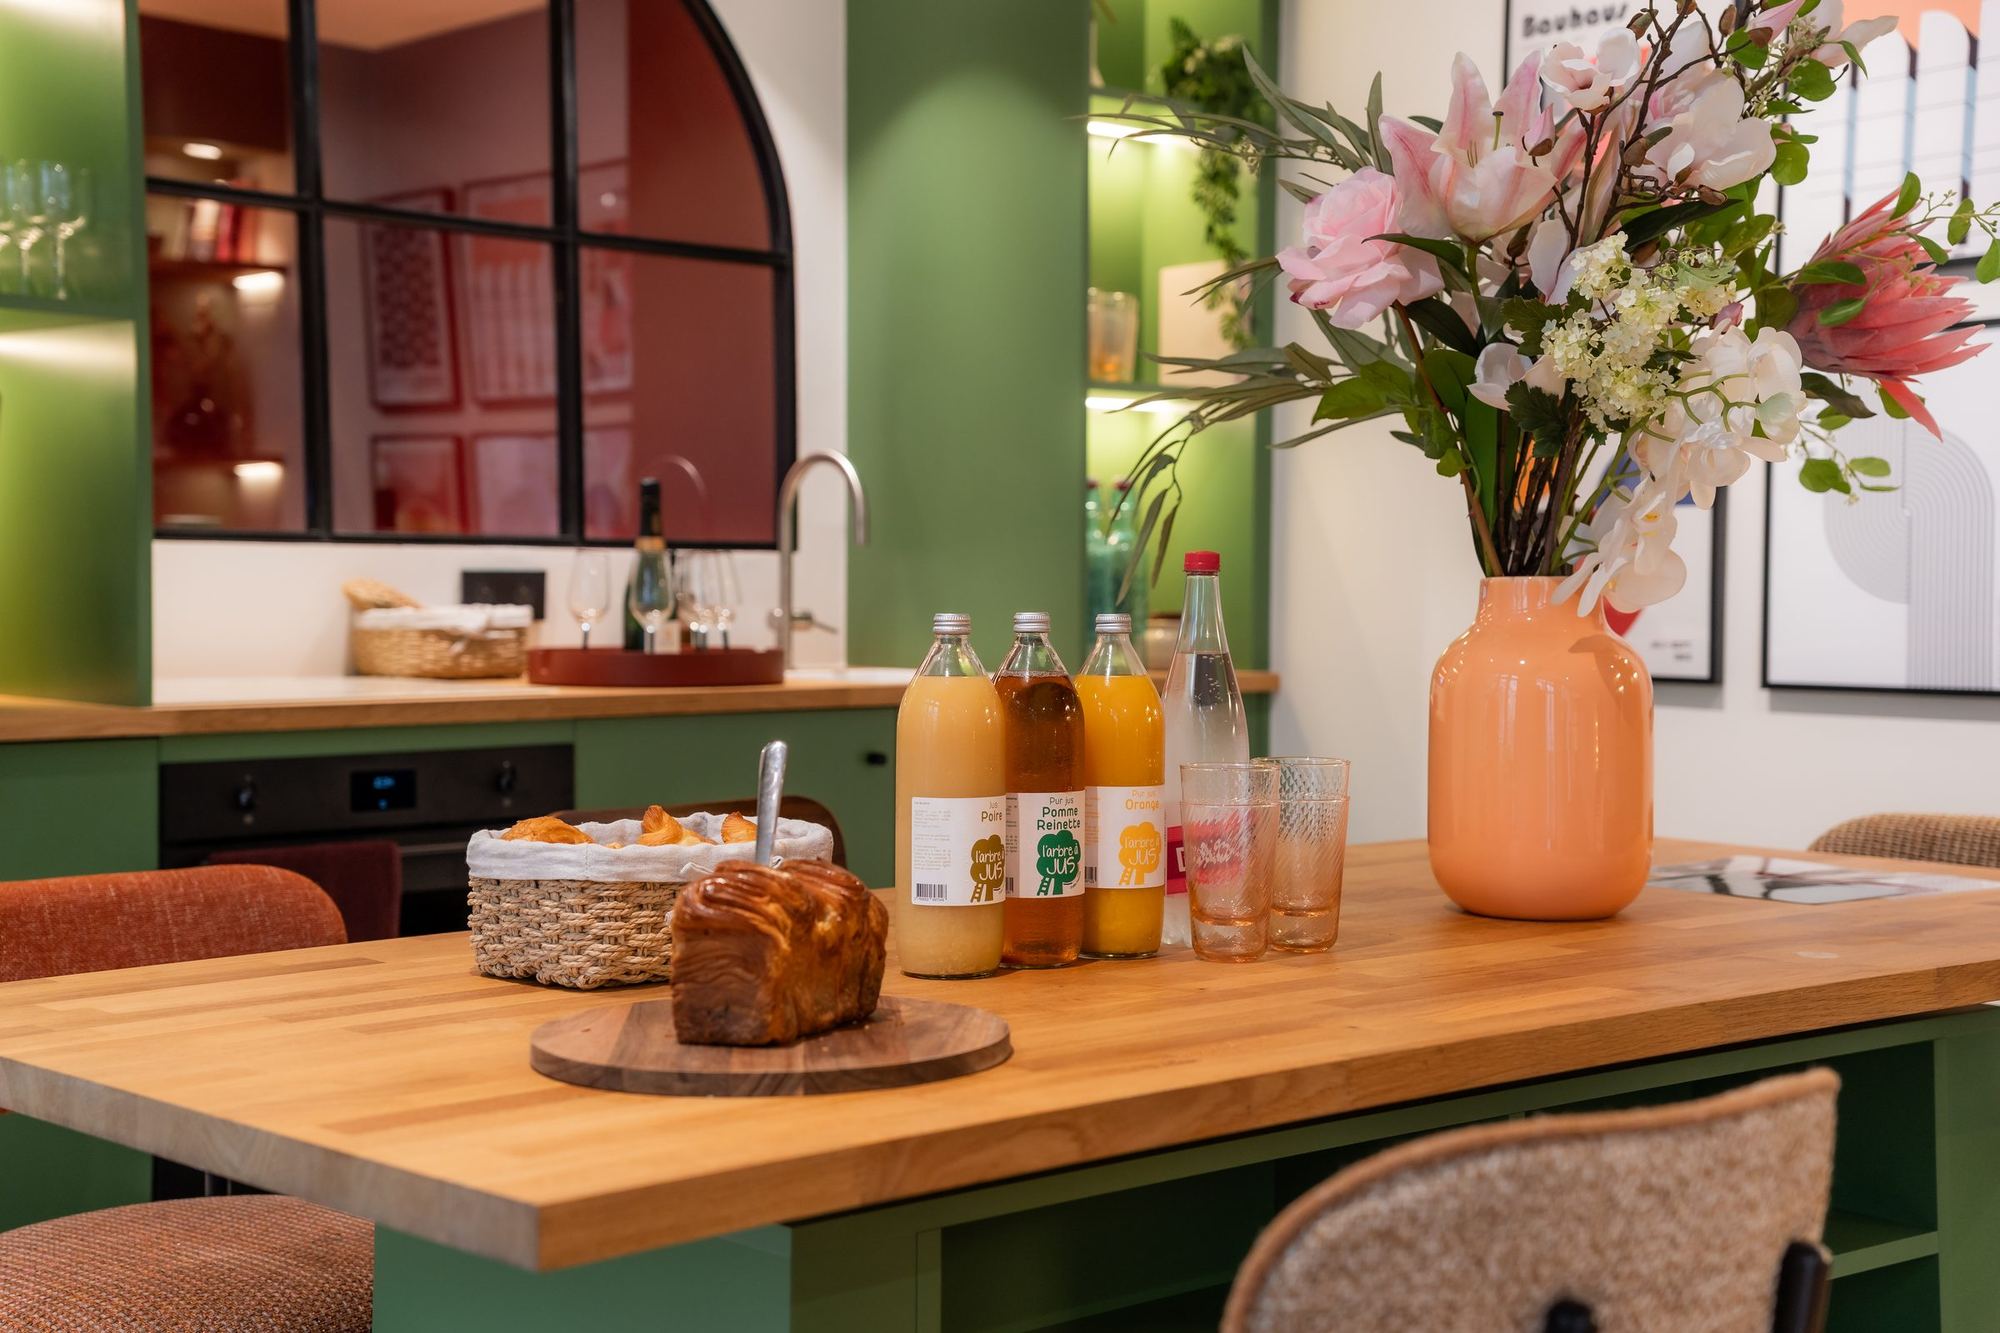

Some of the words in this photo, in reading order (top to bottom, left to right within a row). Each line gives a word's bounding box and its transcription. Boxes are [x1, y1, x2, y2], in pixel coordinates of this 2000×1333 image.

[1049, 796, 1063, 805] Pur
[1064, 797, 1074, 806] jus
[981, 810, 1002, 822] Poire
[1042, 806, 1078, 817] Pomme
[1037, 819, 1080, 830] Reinette
[1042, 844, 1073, 857] l'arbre
[1046, 857, 1076, 875] JUS
